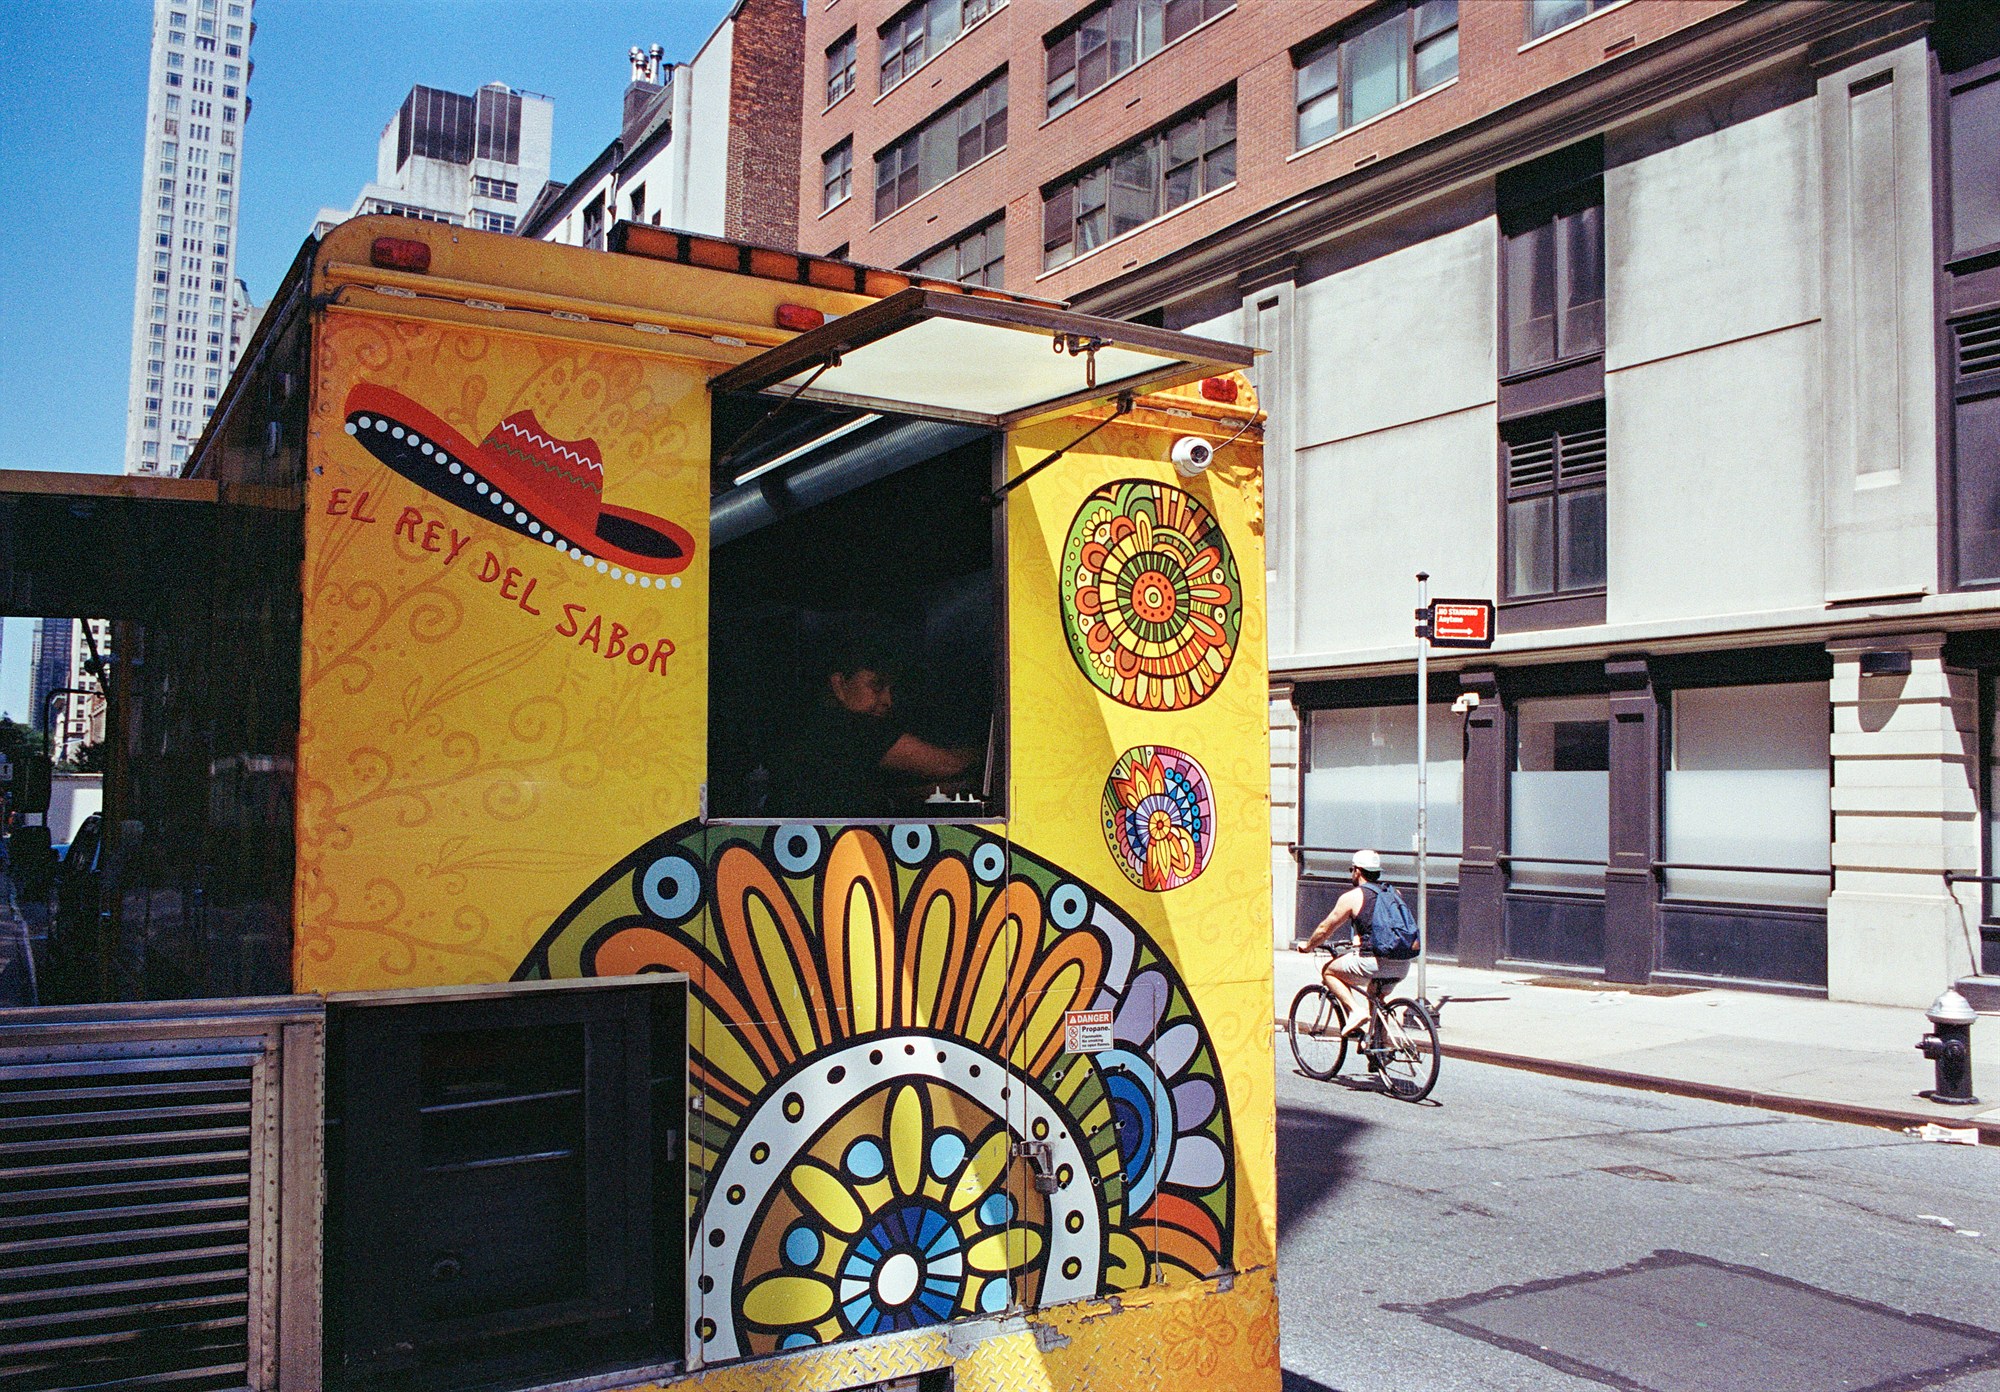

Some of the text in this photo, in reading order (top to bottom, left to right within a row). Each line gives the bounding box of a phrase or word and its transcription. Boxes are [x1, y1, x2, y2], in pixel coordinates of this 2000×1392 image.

[328, 488, 376, 524] EL
[395, 507, 471, 565] REY
[478, 552, 541, 616] DEL
[1077, 1013, 1110, 1023] DANGER
[1081, 1025, 1111, 1033] Propane.
